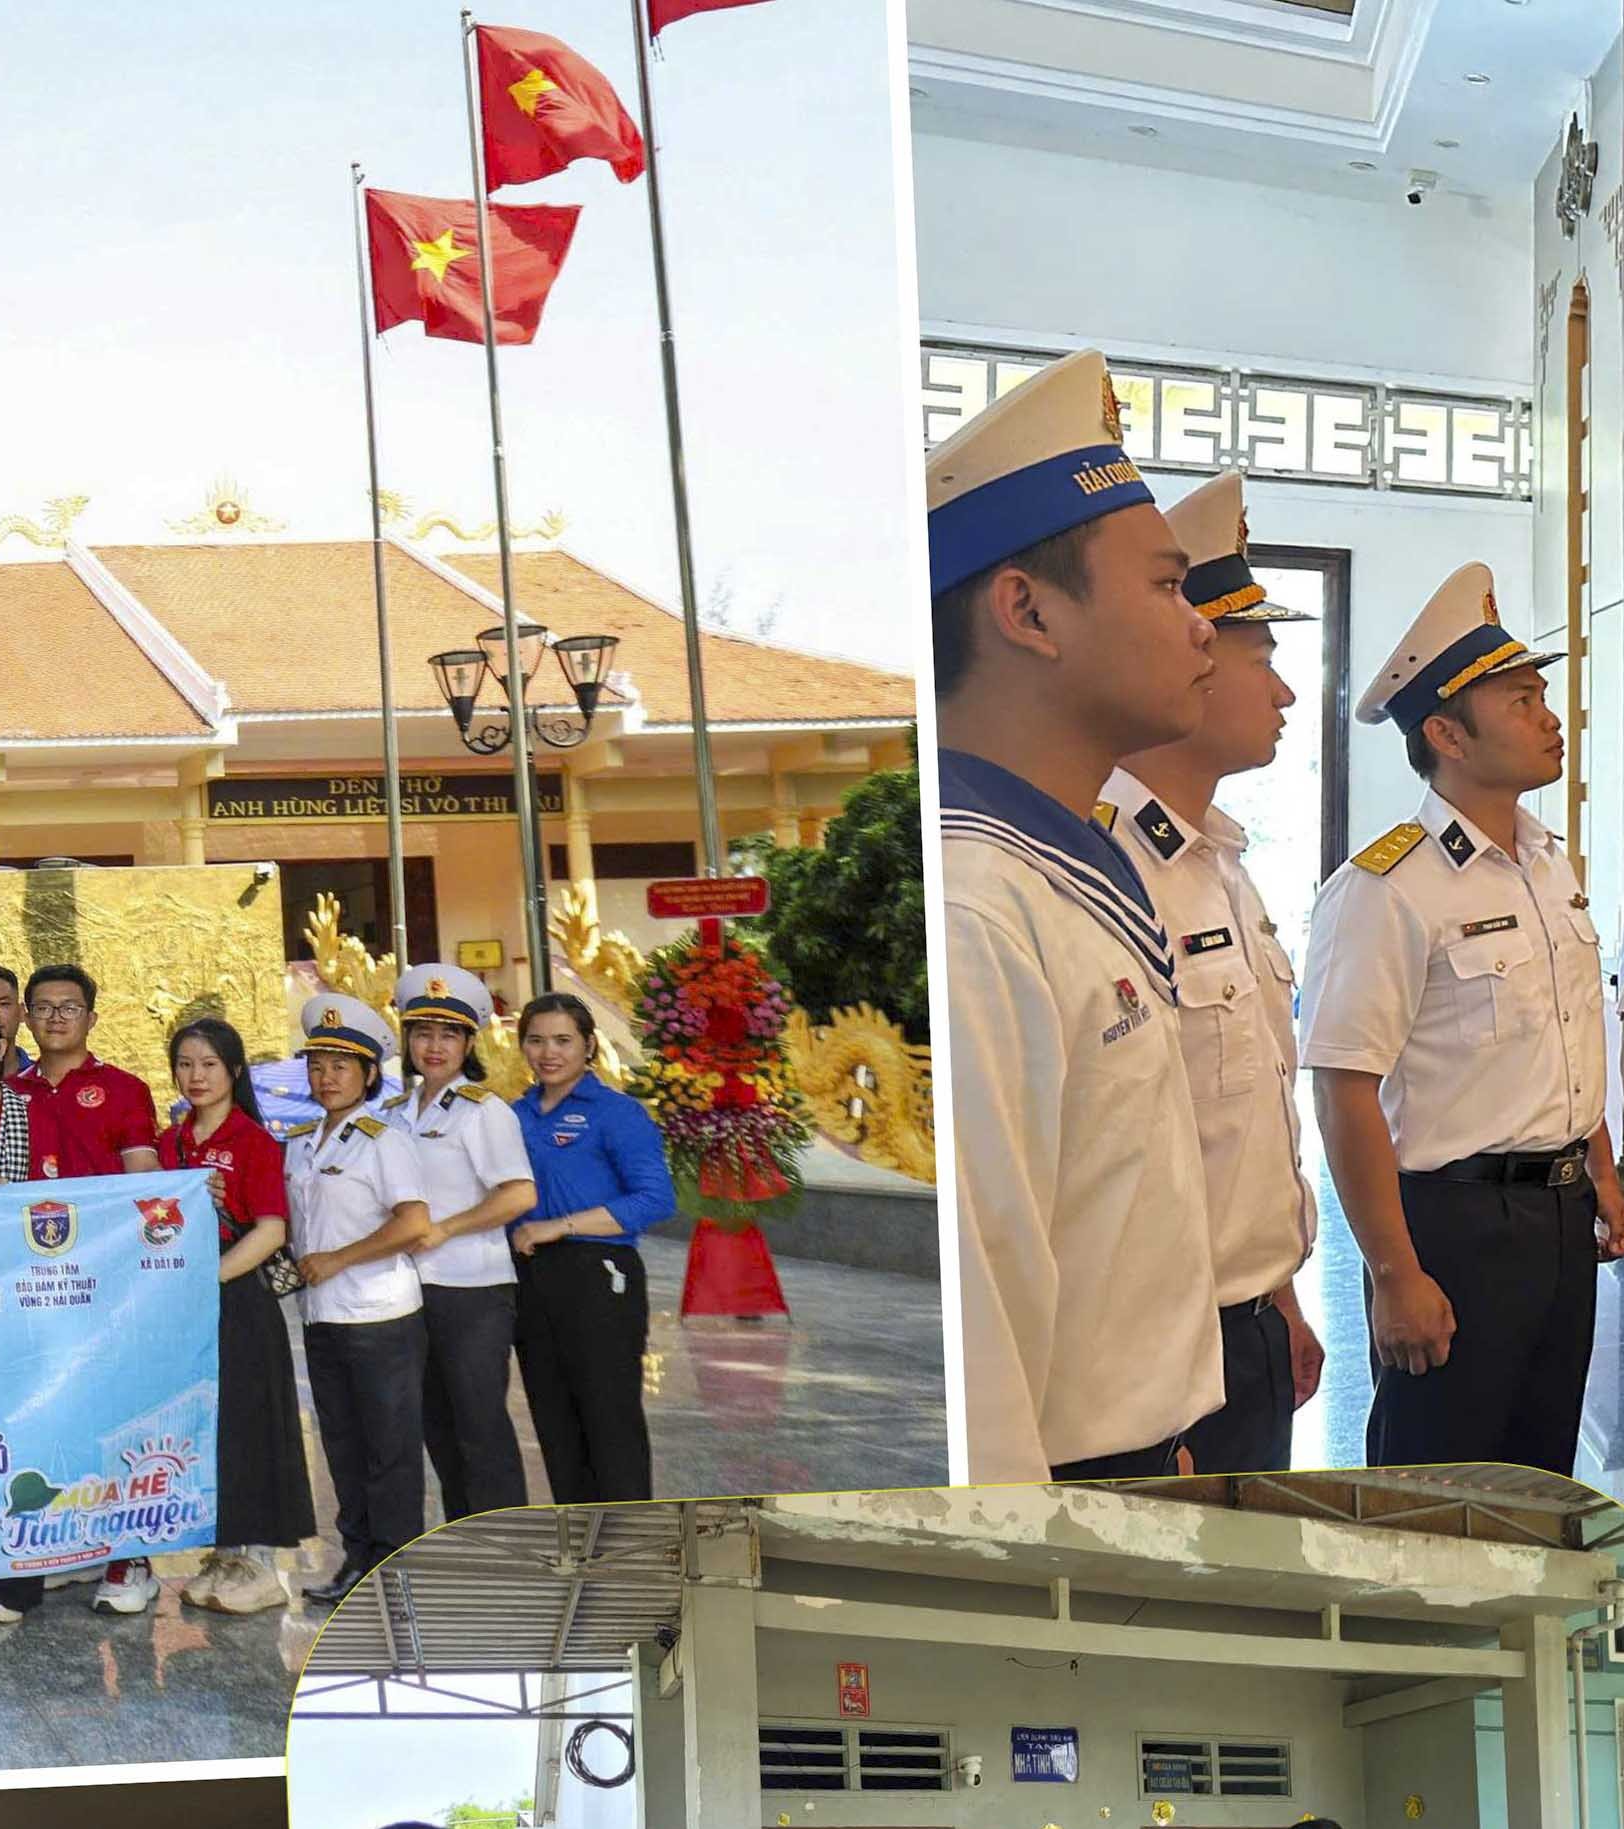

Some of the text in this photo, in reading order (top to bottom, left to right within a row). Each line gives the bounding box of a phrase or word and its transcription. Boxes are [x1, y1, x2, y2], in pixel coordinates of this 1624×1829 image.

[1073, 461, 1110, 495] HẢI
[213, 795, 507, 818] ANH HÙNG THỊ
[30, 1264, 56, 1277] TRUNG
[52, 1467, 170, 1511] MÙA HÈ
[9, 1495, 201, 1548] Tình nguyện
